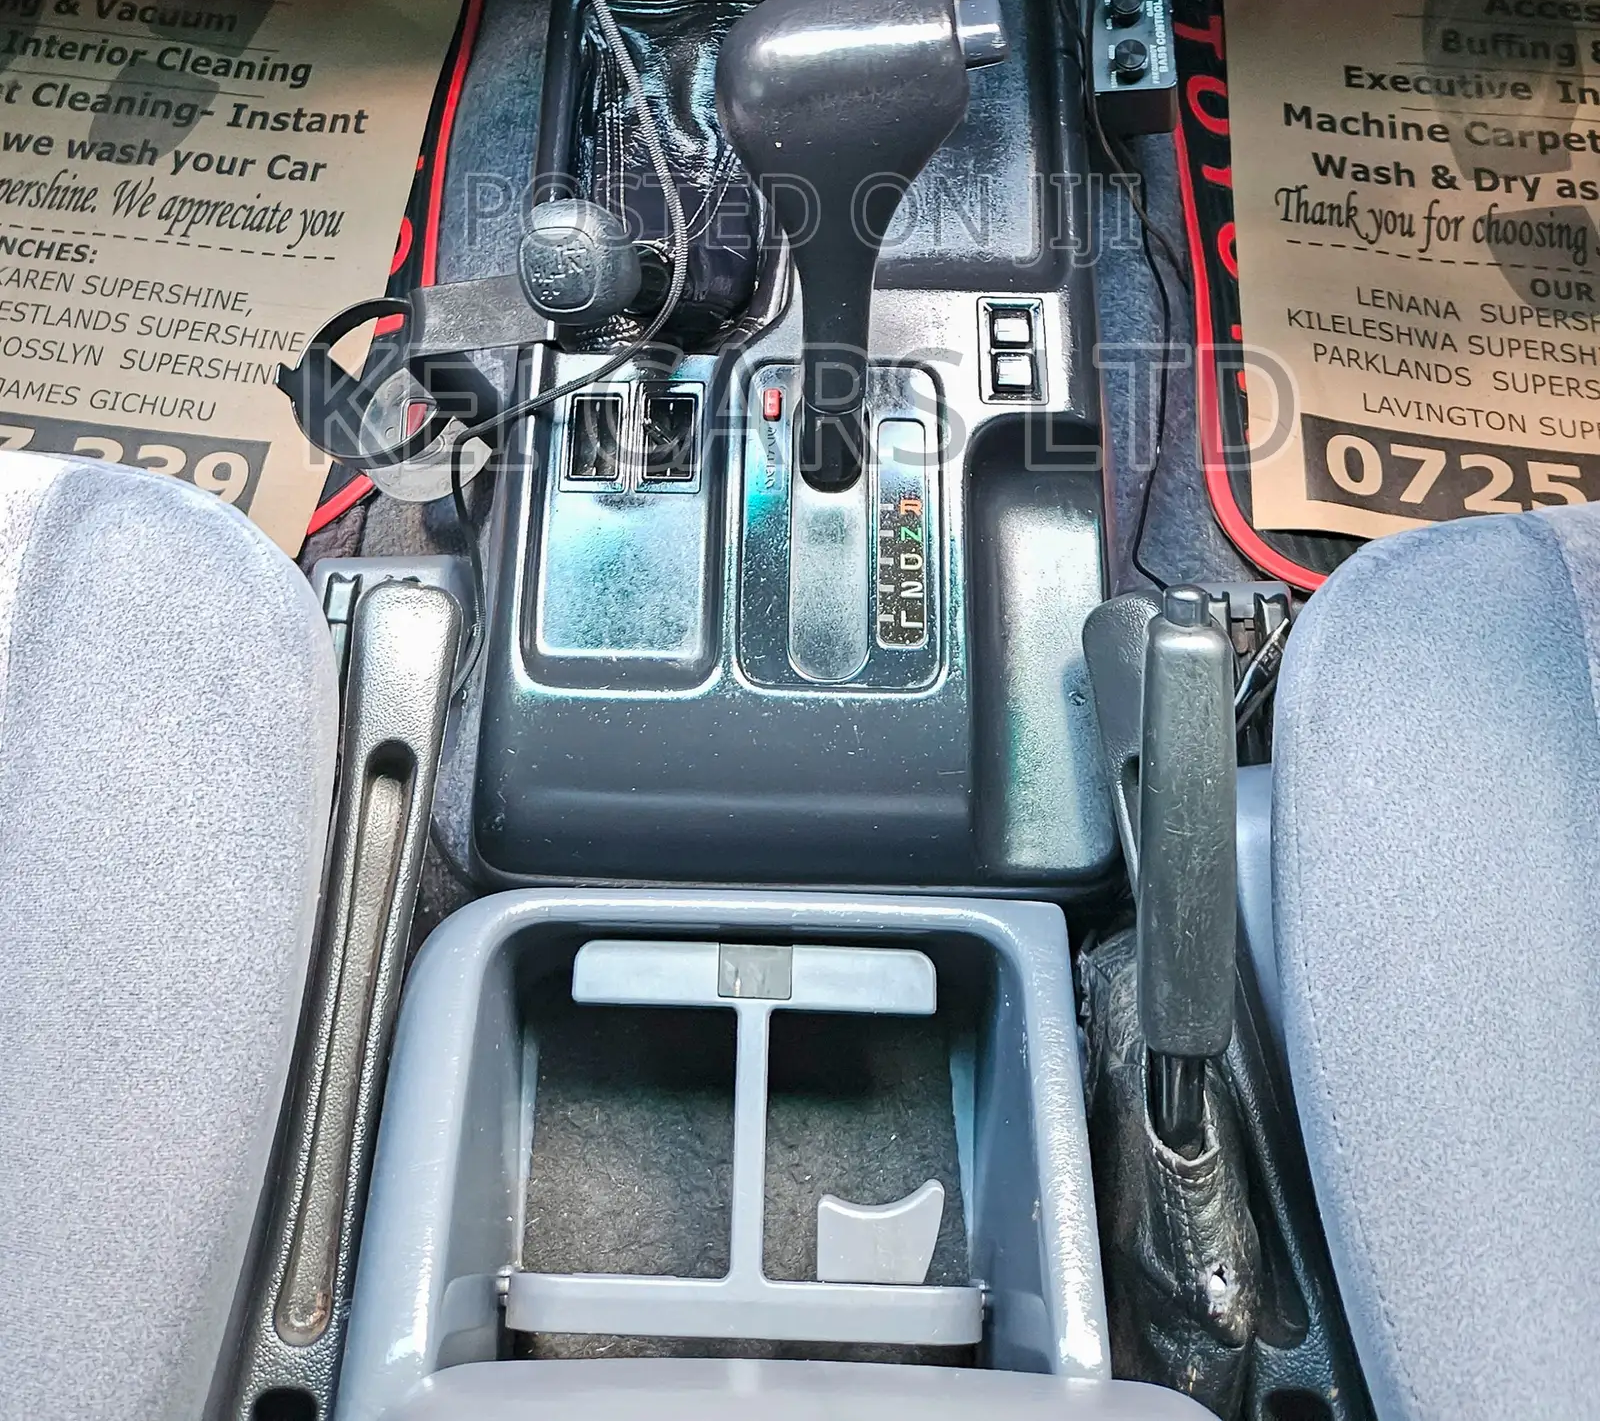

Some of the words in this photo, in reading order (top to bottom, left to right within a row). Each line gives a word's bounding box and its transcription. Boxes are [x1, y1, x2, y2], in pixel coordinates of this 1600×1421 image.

[1153, 0, 1166, 45] CONTROL
[1, 29, 146, 66] Interior
[155, 46, 313, 89] Cleaning
[1440, 28, 1577, 68] Buffing
[1342, 64, 1533, 100] Executive
[225, 102, 370, 135] Instant
[1282, 101, 1450, 143] Machine
[1463, 120, 1600, 155] Carpet
[3, 131, 56, 156] we
[67, 138, 160, 167] wash
[171, 149, 257, 177] your
[266, 154, 328, 183] Car
[1311, 150, 1417, 189] Wash
[1430, 163, 1463, 191] &
[1473, 166, 1542, 202] Dry
[1556, 177, 1600, 201] as
[112, 176, 158, 220] We
[157, 192, 295, 239] appreciate
[286, 208, 347, 251] you
[1274, 183, 1366, 241] Thank
[1362, 206, 1417, 246] you
[1416, 197, 1466, 254] for
[1472, 201, 1588, 267] choosing
[81, 274, 255, 318] SUPERSHINE,
[1355, 284, 1463, 323] LENANA
[1530, 278, 1596, 303] OUR
[136, 315, 307, 354] SUPERSHINE
[1286, 307, 1459, 354] KILELESHWA
[1311, 341, 1473, 388] PARKLANDS
[1491, 369, 1600, 401] SUPERS
[89, 388, 218, 422] GICHURU
[1362, 391, 1528, 435] LAVINGTON
[1538, 415, 1600, 441] SUP
[1325, 434, 1588, 515] 0725
[899, 499, 922, 515] R
[900, 527, 922, 542] N
[900, 553, 923, 571] D
[900, 581, 924, 598] 2
[900, 610, 924, 629] L
